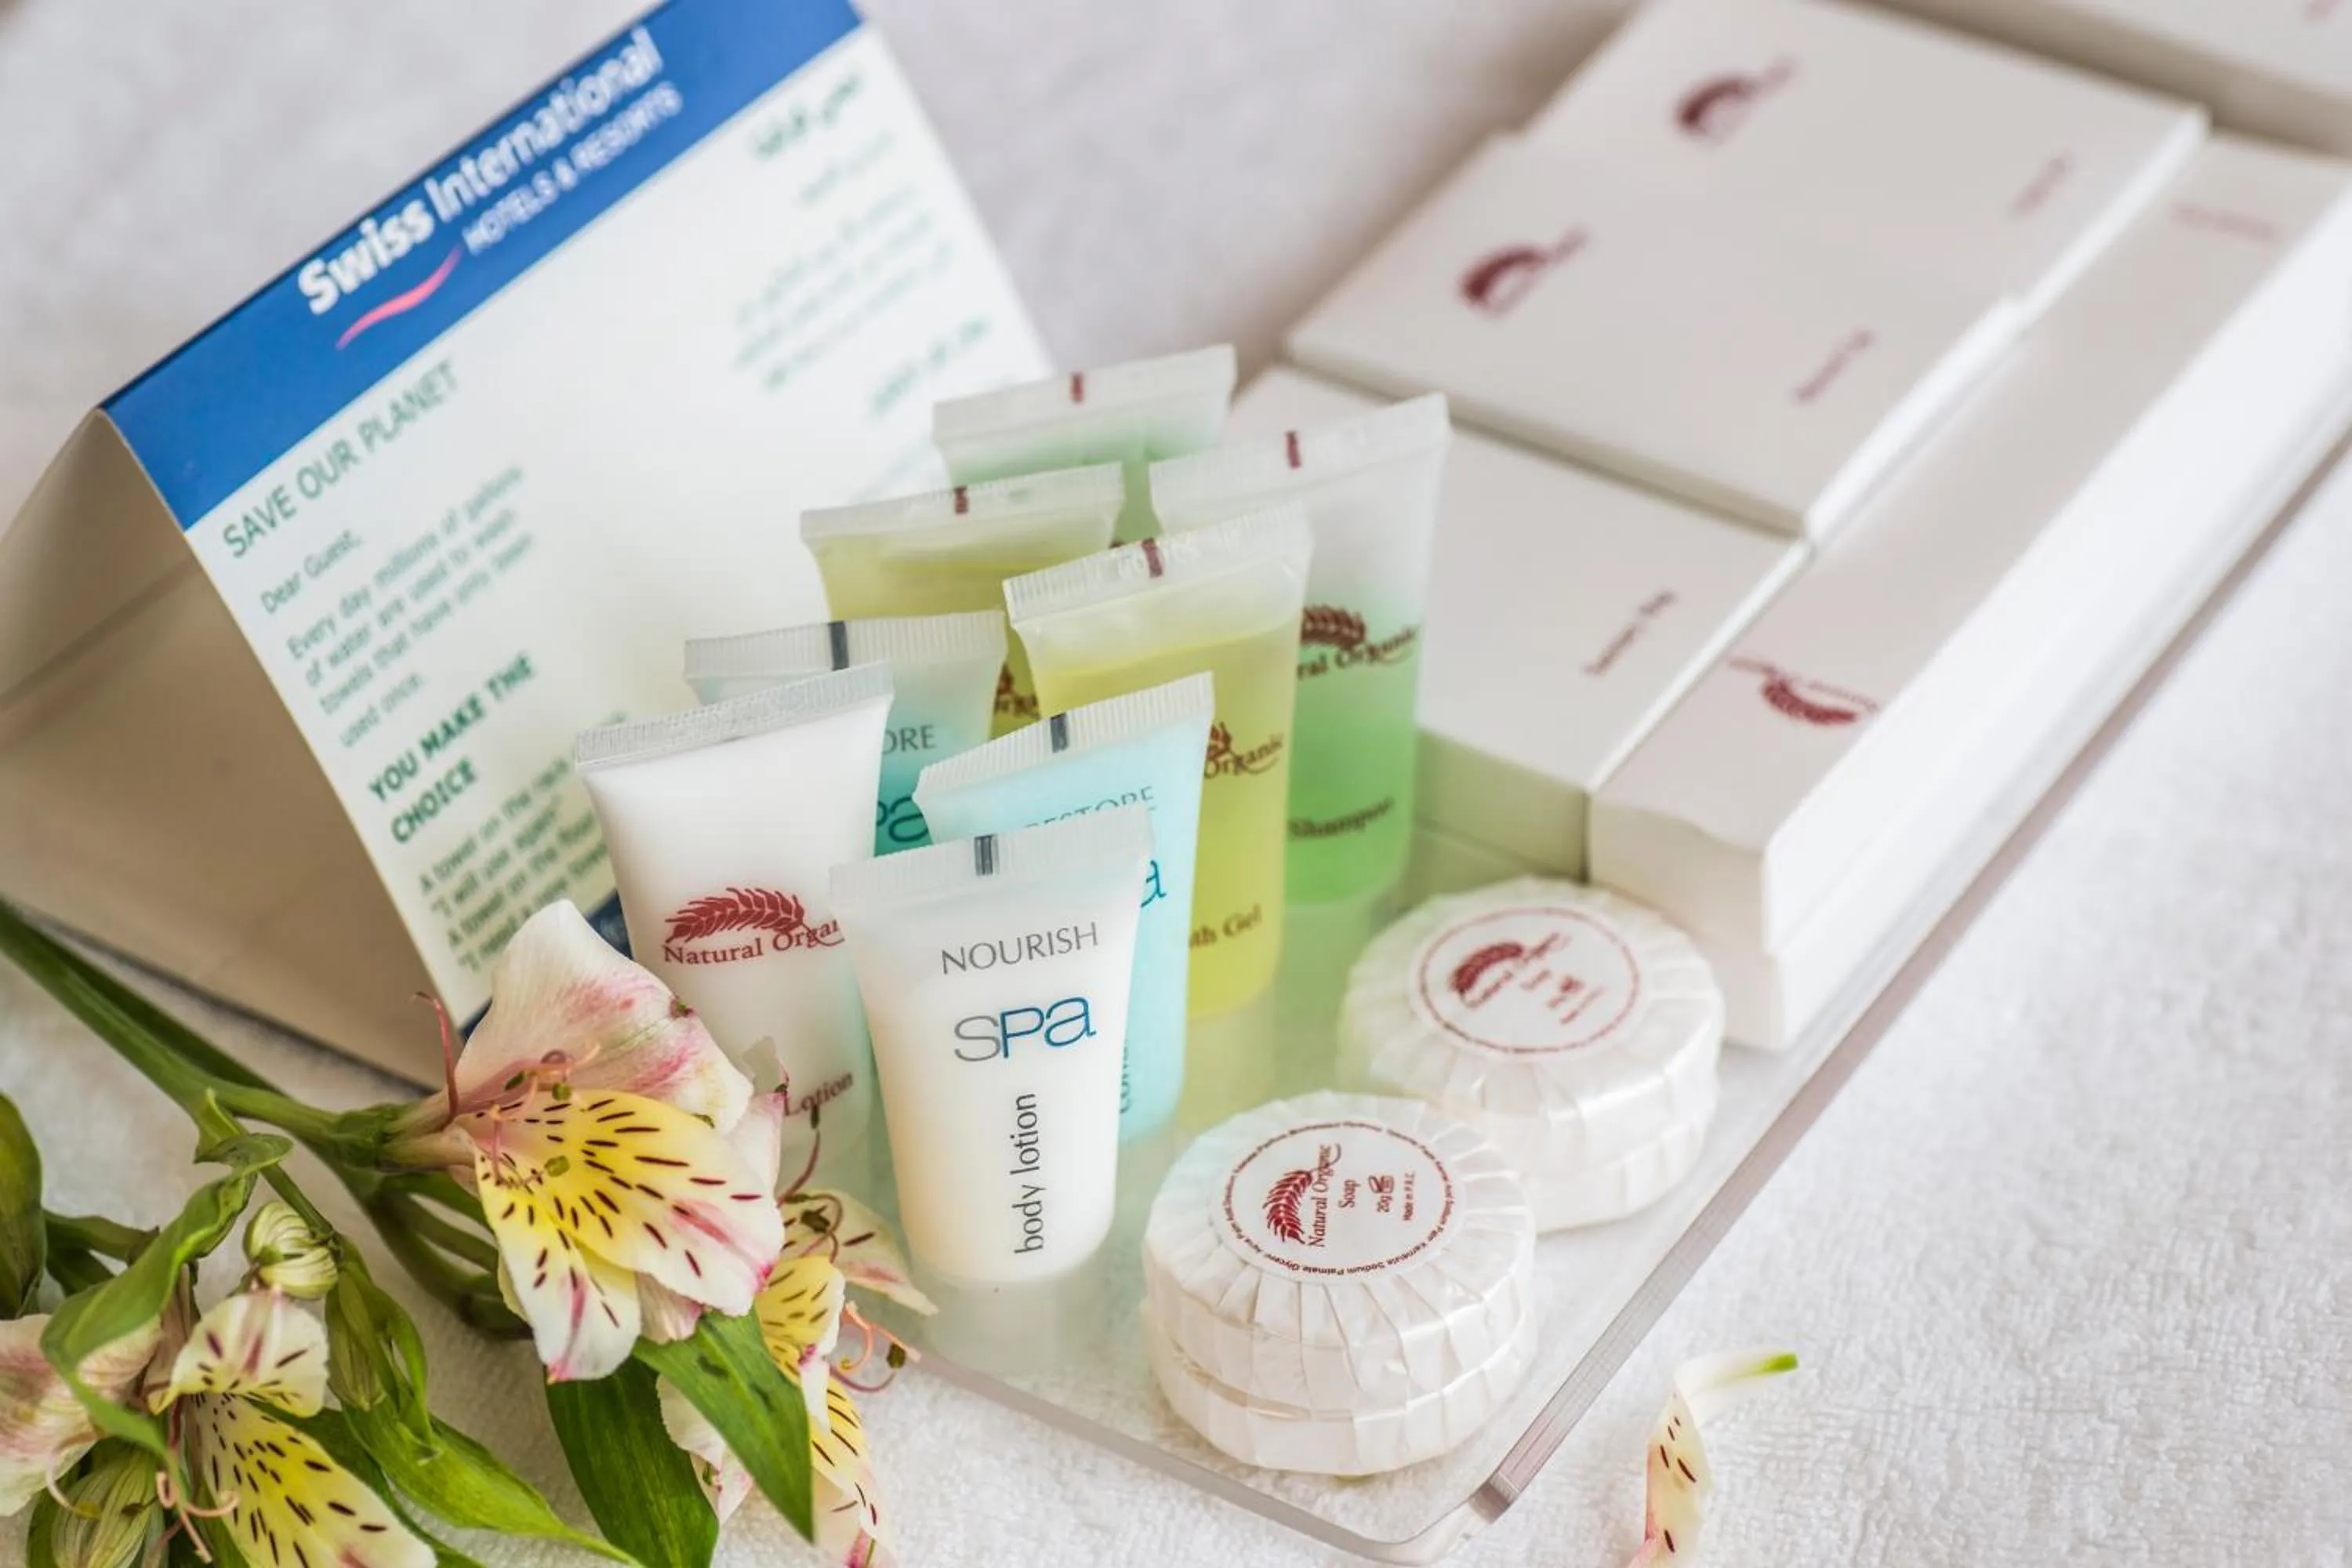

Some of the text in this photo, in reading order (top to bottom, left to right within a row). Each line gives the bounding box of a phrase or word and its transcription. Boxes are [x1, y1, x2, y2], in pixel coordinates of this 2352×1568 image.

[298, 198, 434, 314] Swiss
[424, 25, 663, 223] International
[461, 170, 558, 256] HOTELS
[568, 81, 684, 174] RESORTS
[223, 360, 454, 558] SAVE OUR PLANET
[260, 574, 301, 614] Dear
[369, 655, 532, 801] YOU MAKE THE
[391, 758, 476, 844] CHOICE
[662, 920, 839, 964] Natural Orga
[942, 922, 1099, 975] NOURISH
[1222, 903, 1261, 937] Gel
[1010, 1094, 1044, 1254] body lotion
[1338, 1178, 1361, 1209] Soap
[1308, 1196, 1327, 1247] Natural
